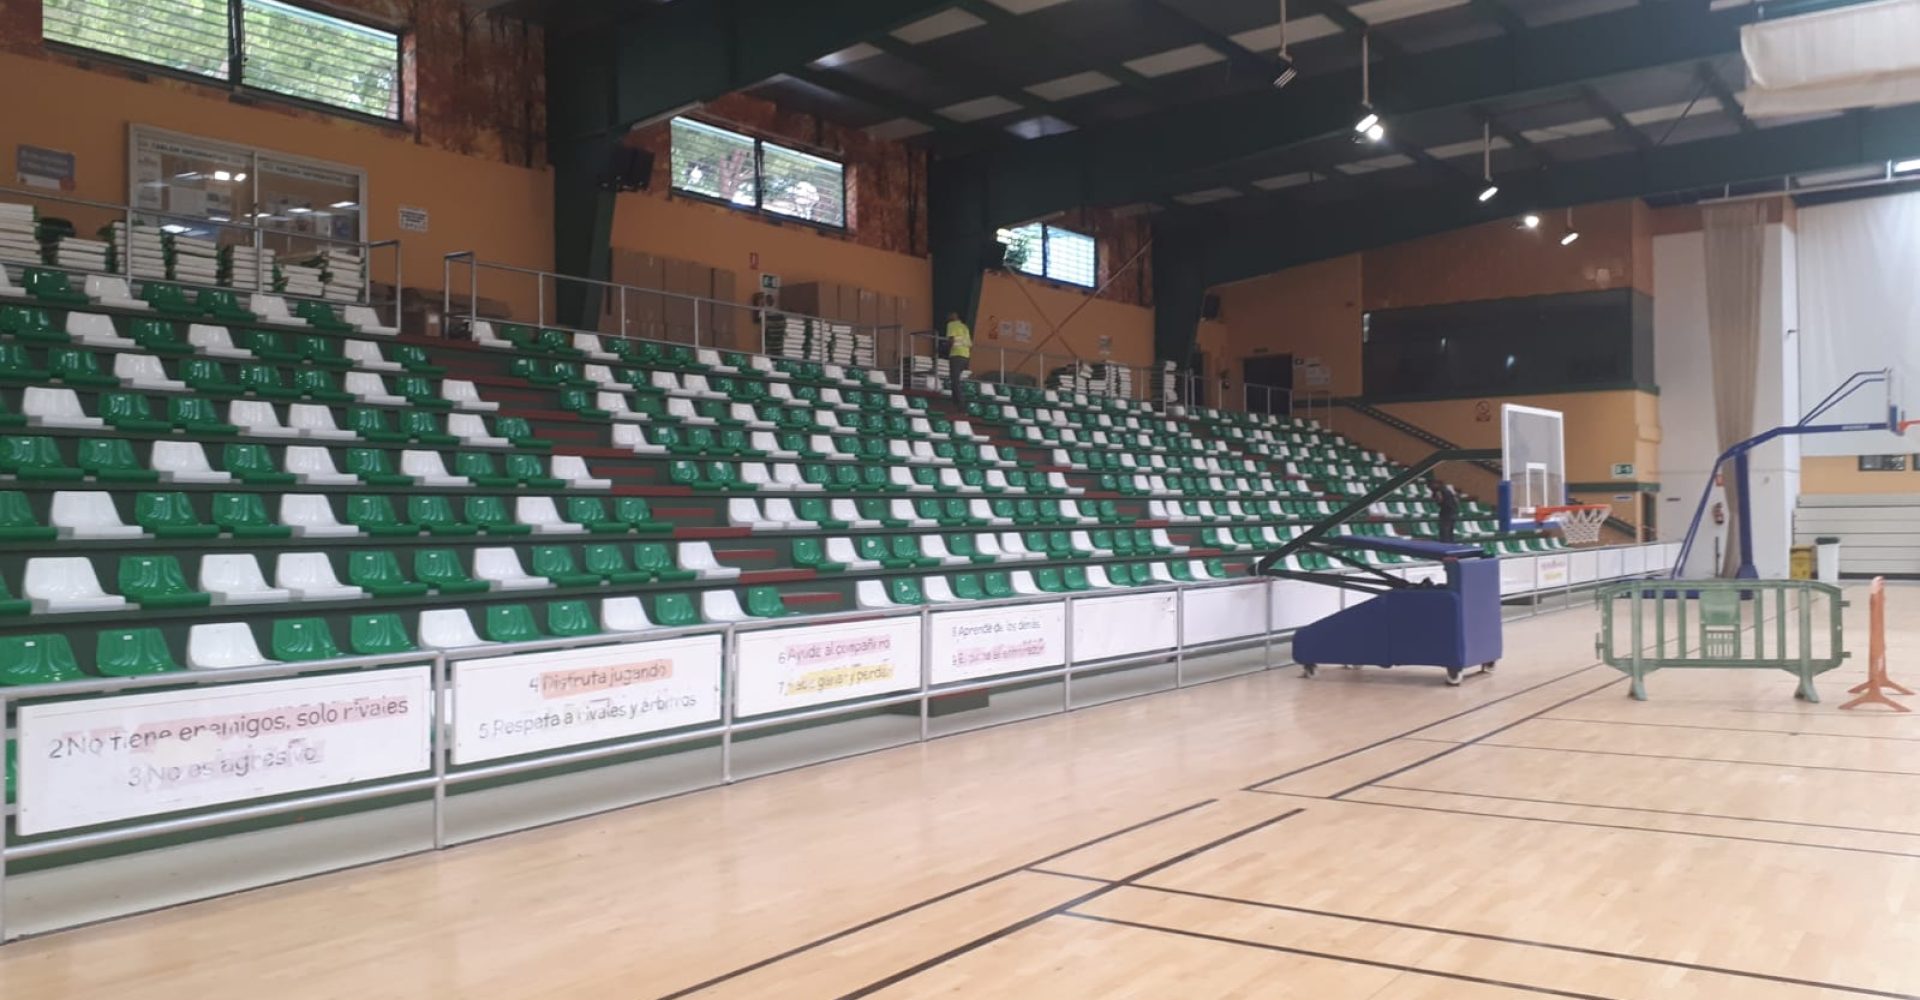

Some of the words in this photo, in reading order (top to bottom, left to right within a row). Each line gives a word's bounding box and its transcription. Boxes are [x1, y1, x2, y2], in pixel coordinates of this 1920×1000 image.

[778, 651, 786, 664] 6
[529, 677, 538, 693] 4
[542, 670, 607, 690] Disfruta
[609, 663, 667, 687] jugando
[49, 738, 64, 759] 2
[296, 702, 338, 727] solo
[343, 697, 409, 720] rivales
[479, 722, 489, 739] 5
[493, 711, 561, 735] Respeta
[563, 711, 574, 725] a
[629, 703, 638, 719] y
[128, 766, 141, 787] 3
[148, 764, 181, 782] No
[188, 762, 214, 777] es
